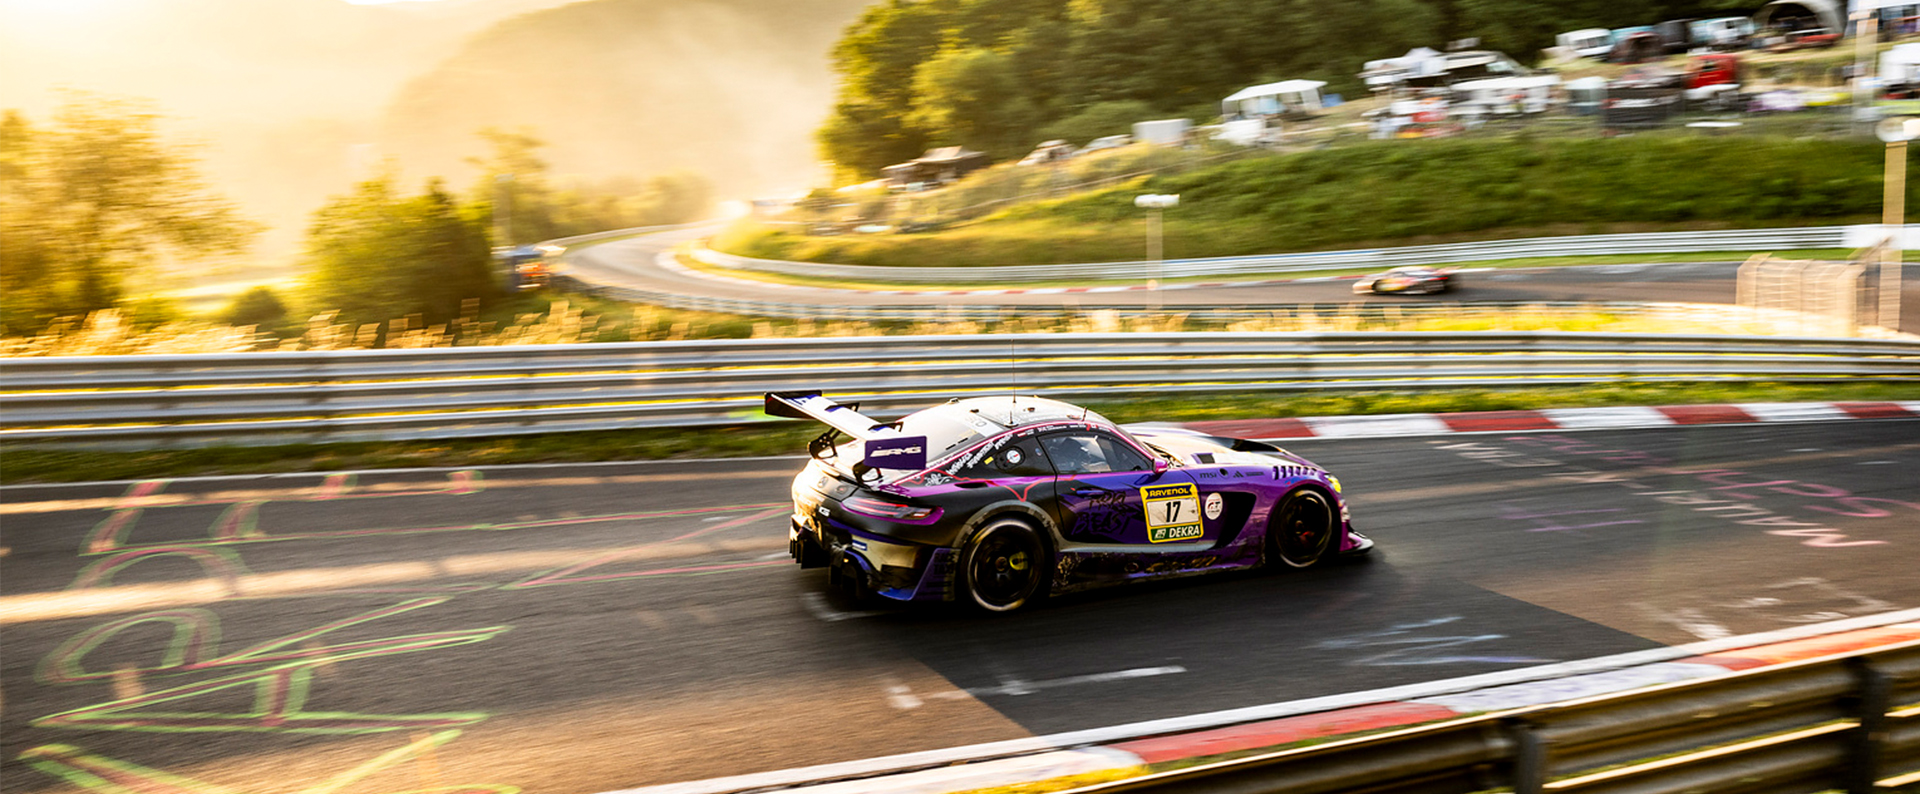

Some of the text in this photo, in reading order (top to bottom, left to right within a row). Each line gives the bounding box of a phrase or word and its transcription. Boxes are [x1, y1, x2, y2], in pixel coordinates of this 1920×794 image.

[886, 445, 922, 456] AMG
[1199, 471, 1217, 479] msi
[1149, 488, 1190, 498] RAVENOL
[1165, 501, 1182, 523] 17
[1168, 525, 1200, 538] DEKRA
